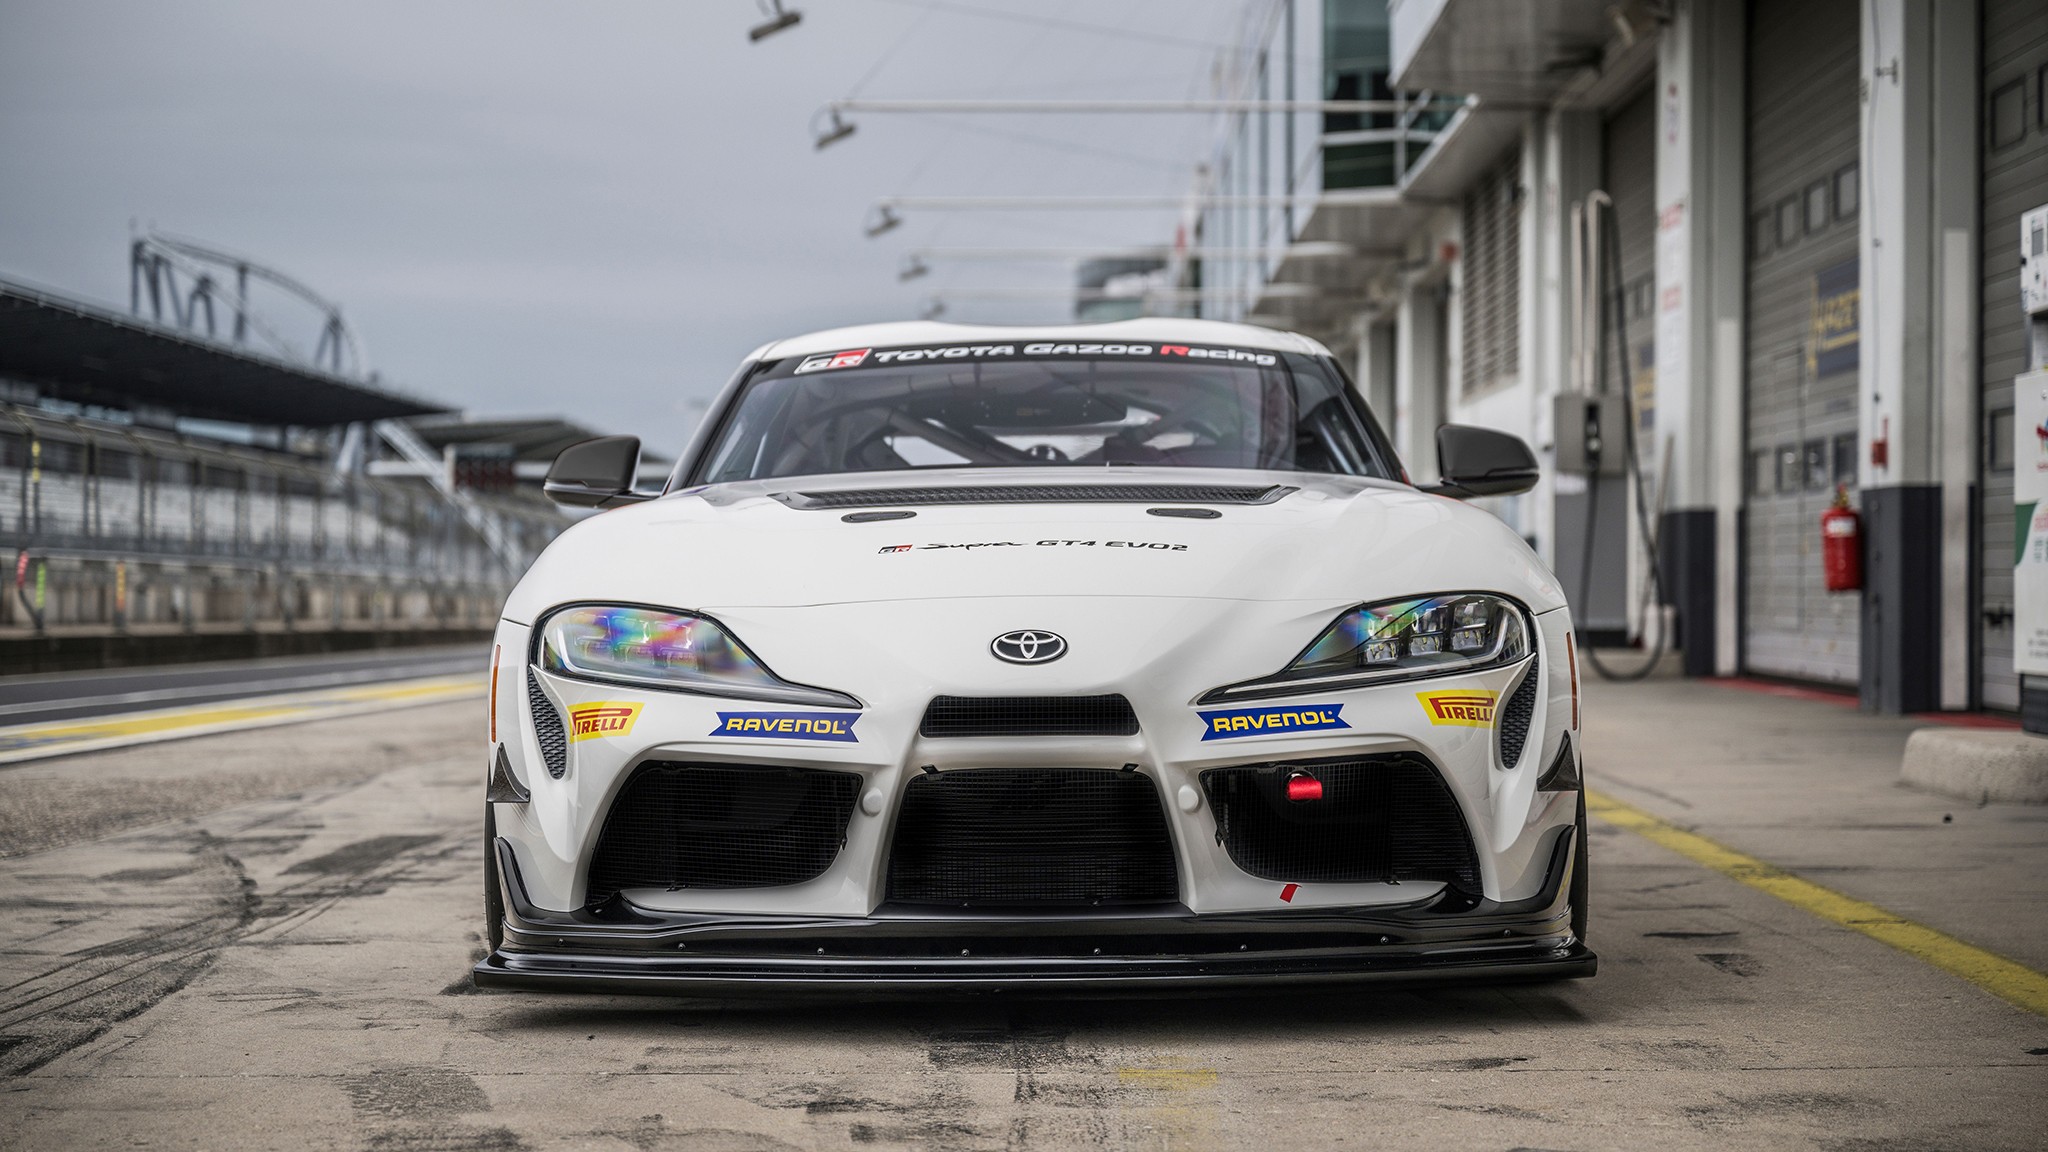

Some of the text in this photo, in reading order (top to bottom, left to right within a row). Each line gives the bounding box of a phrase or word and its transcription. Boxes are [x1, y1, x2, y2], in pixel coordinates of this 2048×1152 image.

[797, 343, 1277, 373] GR TOYOTA GAZOO Racing
[916, 541, 1028, 551] Supra
[1036, 539, 1097, 547] GT4
[571, 707, 633, 736] PIRELLI
[725, 718, 847, 735] RAVENOL
[1212, 710, 1336, 733] RAVENOL
